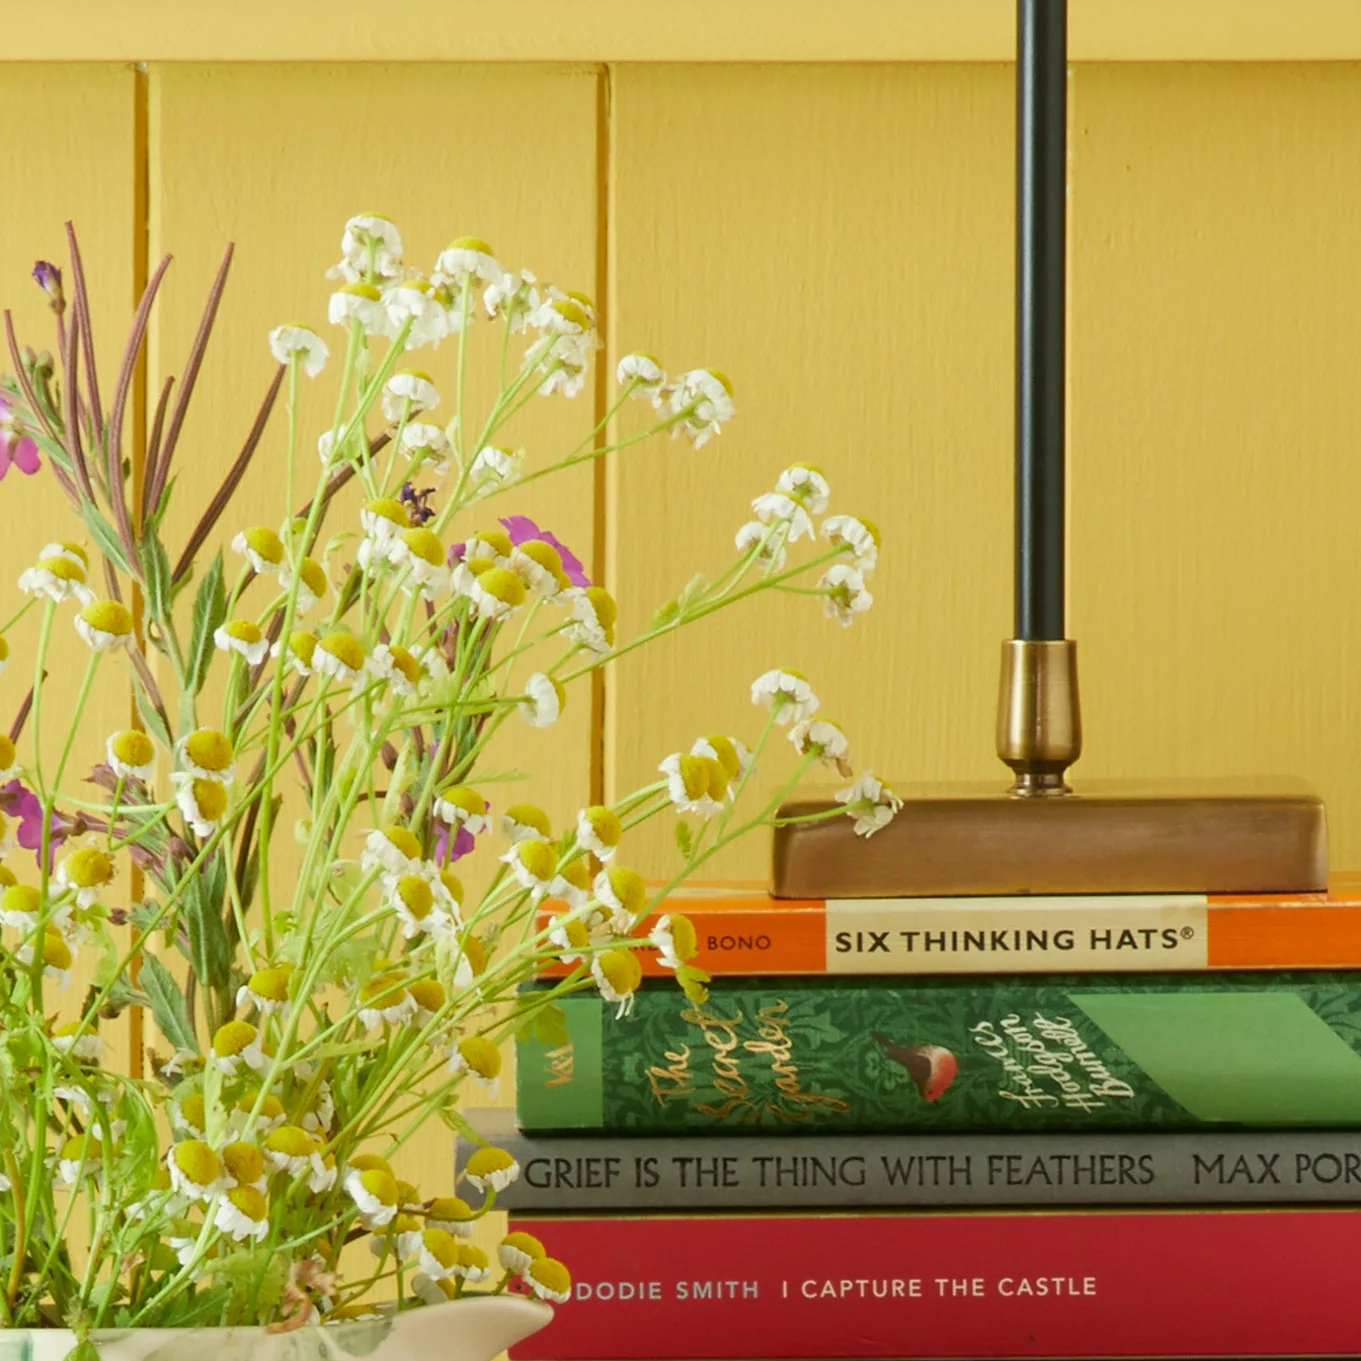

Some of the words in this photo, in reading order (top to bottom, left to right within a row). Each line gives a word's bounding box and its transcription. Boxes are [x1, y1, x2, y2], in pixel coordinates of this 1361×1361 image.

[707, 935, 772, 951] BONO
[835, 931, 889, 953] SIX
[901, 929, 1075, 952] THINKING
[543, 1042, 574, 1088] V&A
[645, 1042, 692, 1108] The
[679, 1008, 760, 1122] Secret
[743, 999, 851, 1122] Garden
[968, 1021, 1059, 1110] Frances
[999, 1013, 1106, 1114] Hodgson
[1033, 1011, 1136, 1099] Burnett
[524, 1157, 621, 1189] GRIEF
[635, 1157, 661, 1188] IS
[672, 1156, 740, 1188] THE
[752, 1156, 867, 1187] THING
[880, 1155, 973, 1187] WITH
[987, 1154, 1156, 1187] FEATHERS
[1192, 1153, 1282, 1185] MAX
[575, 1281, 662, 1301] DODIE
[675, 1280, 760, 1300] SMITH
[781, 1279, 789, 1299] I
[801, 1279, 923, 1299] CAPTURE
[935, 1278, 985, 1297] THE
[998, 1277, 1097, 1297] CASTLE
